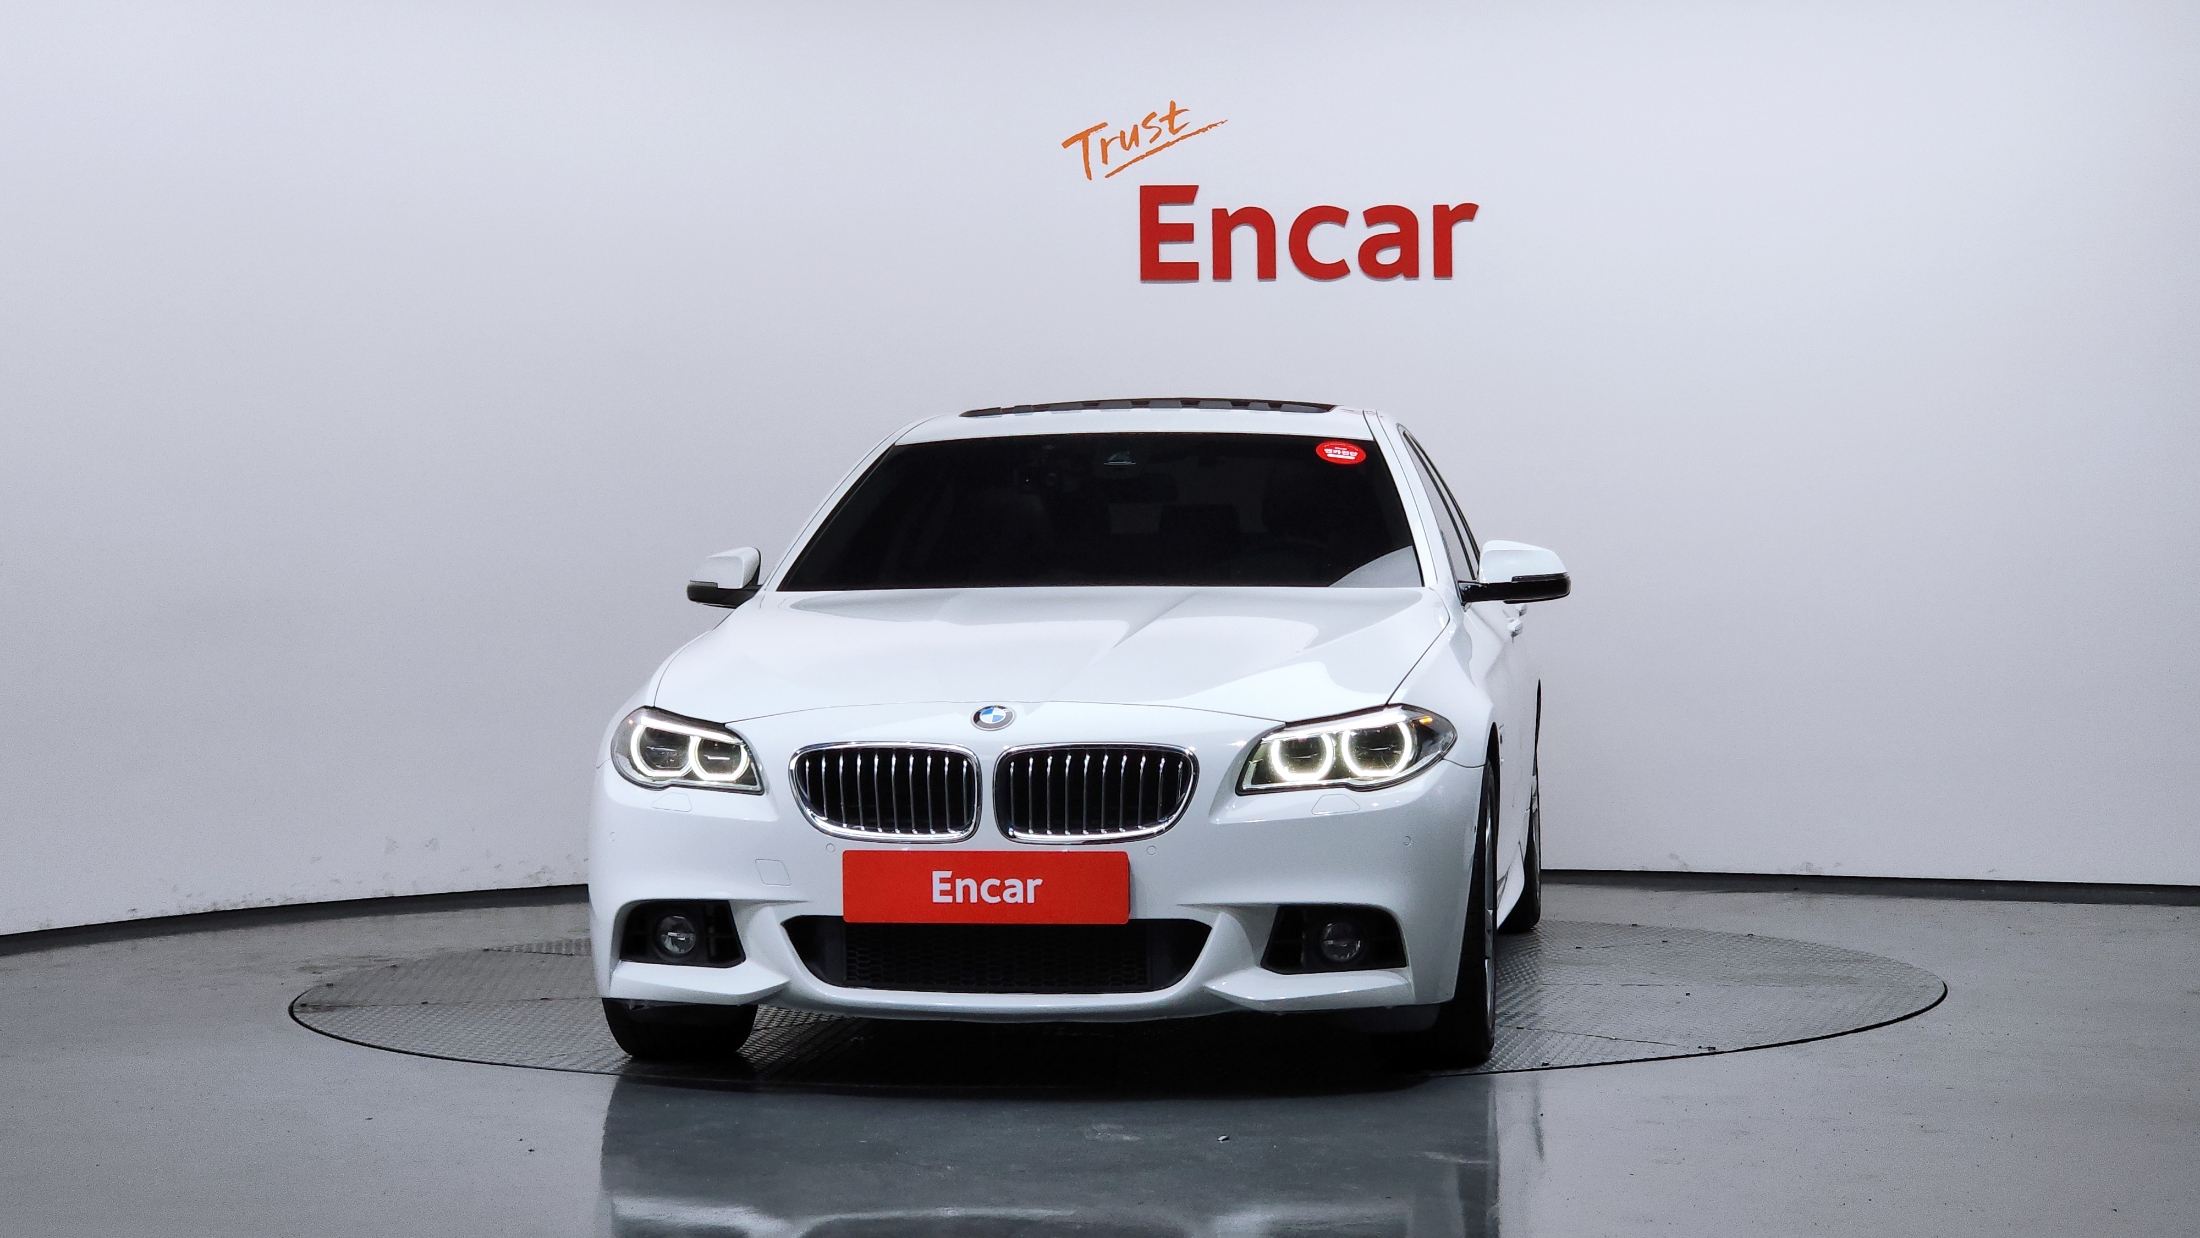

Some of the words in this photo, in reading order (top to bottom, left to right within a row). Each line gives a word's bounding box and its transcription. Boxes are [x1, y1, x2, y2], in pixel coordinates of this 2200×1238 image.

[1061, 100, 1191, 181] Trust
[1139, 184, 1480, 283] Encar
[932, 870, 1043, 904] Encar
